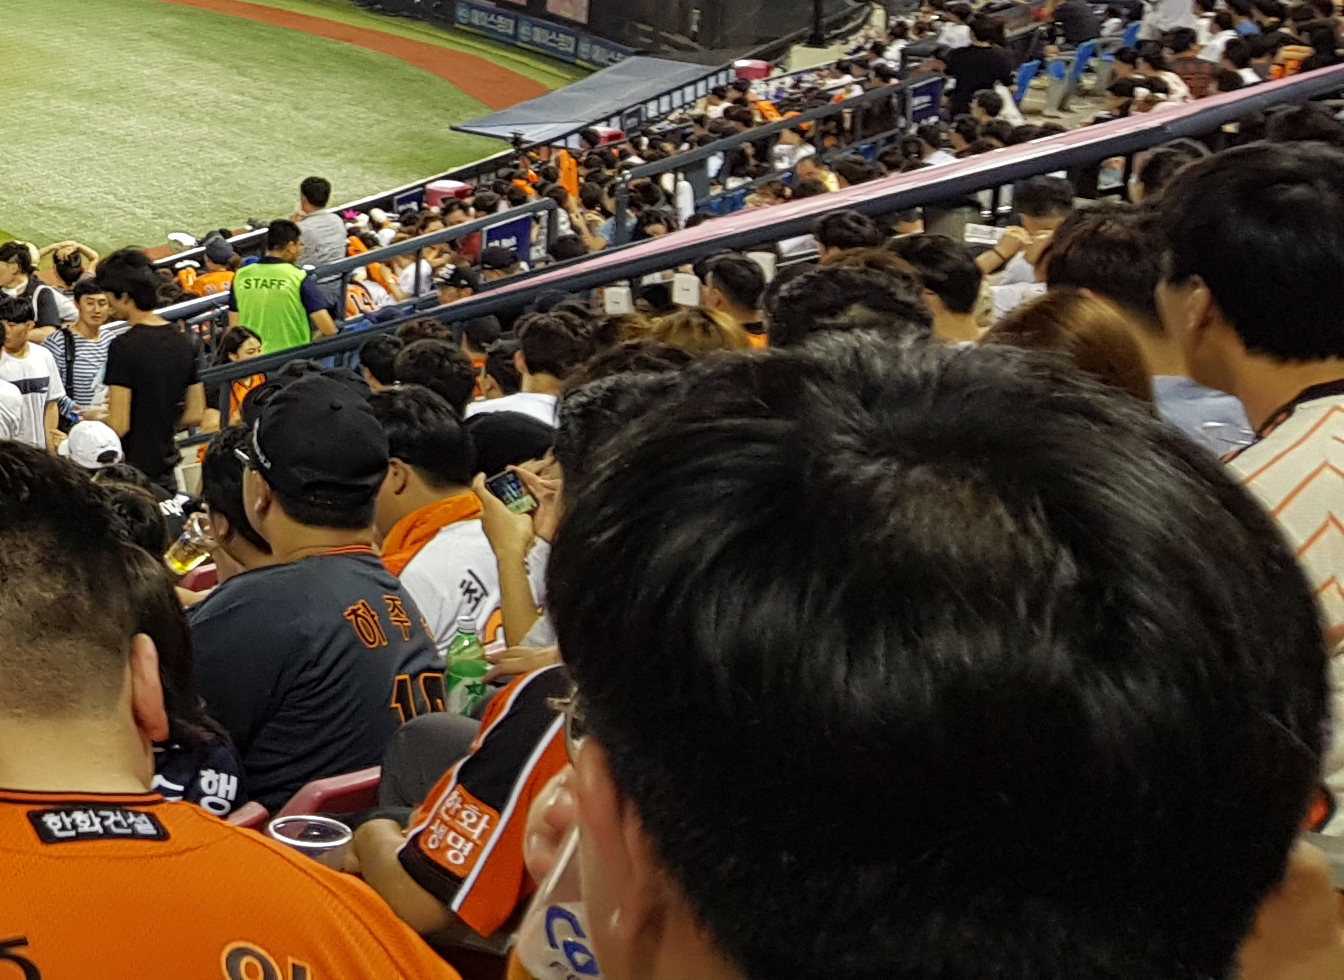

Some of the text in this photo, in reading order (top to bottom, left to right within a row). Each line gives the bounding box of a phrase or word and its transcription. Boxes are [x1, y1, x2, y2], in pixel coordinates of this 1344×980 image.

[243, 277, 287, 290] STAFF
[42, 809, 159, 838] 한화건설
[441, 789, 491, 843] 한화
